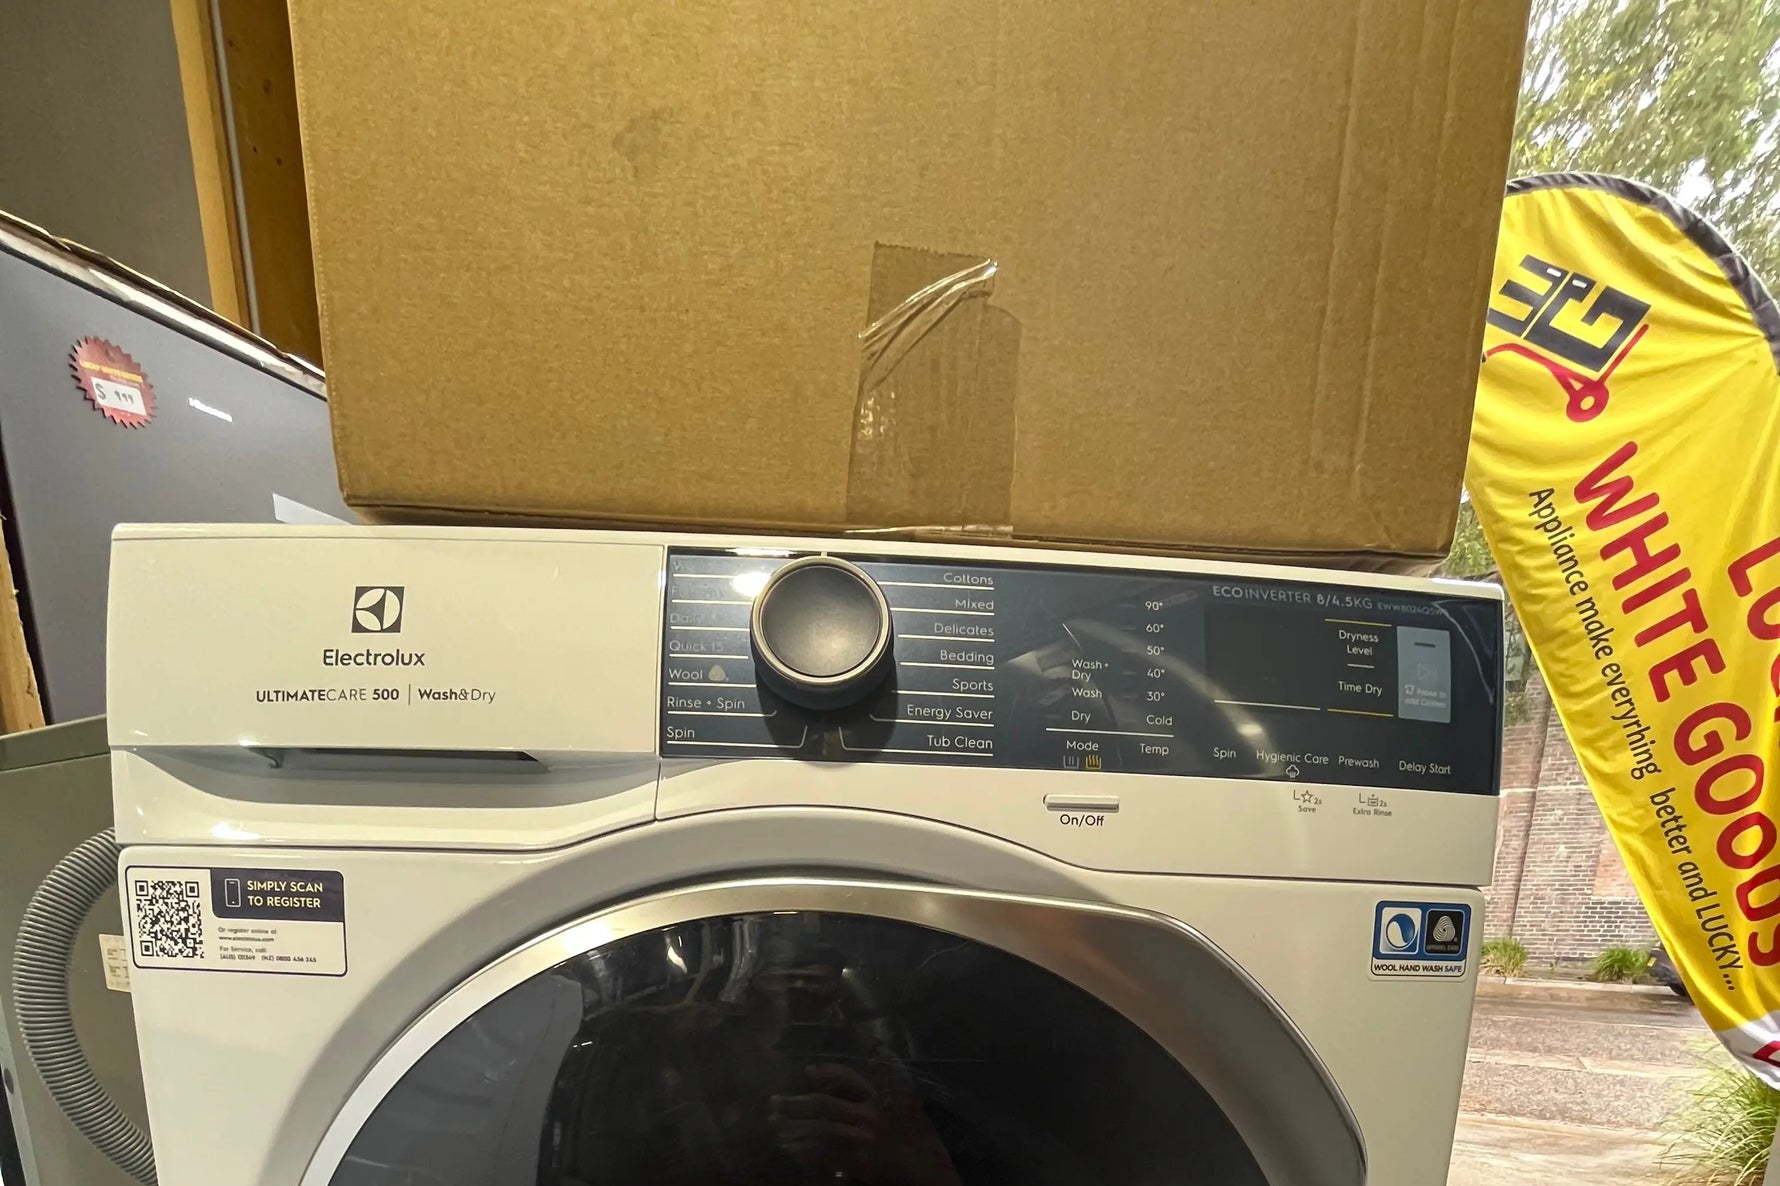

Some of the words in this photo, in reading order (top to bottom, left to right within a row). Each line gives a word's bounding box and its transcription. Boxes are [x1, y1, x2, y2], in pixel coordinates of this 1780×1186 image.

[1574, 440, 1726, 702] WHITE
[943, 572, 994, 586] Cottons
[1212, 585, 1312, 604] ECOINVERTER
[1316, 593, 1373, 610] 8/4.5KG
[955, 598, 994, 611] Mixed
[1145, 600, 1164, 611] 90°
[934, 622, 994, 637] Delicates
[1146, 623, 1165, 633] 60°
[1338, 629, 1380, 644] Dryness
[669, 639, 707, 653] Quick
[712, 640, 725, 654] 15
[1147, 645, 1165, 656] 50°
[1346, 644, 1373, 656] Level
[322, 649, 426, 666] Electrolux
[940, 649, 994, 666] Bedding
[668, 668, 703, 681] Wool
[1071, 670, 1092, 683] Dry
[1147, 667, 1165, 679] 40°
[952, 678, 994, 694] Sports
[1338, 681, 1362, 694] Time
[1364, 682, 1383, 697] Dry
[256, 688, 367, 703] ULTIMATECARE
[372, 688, 400, 701] 500
[418, 688, 496, 704] Wash&Dry
[1072, 687, 1103, 699] Wash
[1146, 691, 1165, 702] 30°
[1528, 487, 1589, 596] Appliance
[1575, 596, 1614, 660] make
[1650, 787, 1692, 855] better
[1677, 860, 1718, 902] and
[667, 696, 701, 709] Rinse
[716, 697, 745, 711] Spin
[907, 704, 951, 720] Energy
[955, 706, 993, 720] Saver
[1071, 710, 1091, 724] Dry
[1146, 714, 1173, 726] Cold
[666, 725, 695, 739] Spin
[927, 734, 950, 748] Tub
[954, 736, 993, 750] Clean
[1066, 740, 1099, 752] Mode
[1139, 743, 1170, 756] Temp
[1213, 747, 1237, 760] Spin
[1256, 750, 1300, 766] Hygienic
[1304, 753, 1329, 766] Care
[1338, 756, 1380, 769] Prewash
[1399, 761, 1423, 775] Delay
[1424, 762, 1452, 776] Start
[1298, 805, 1317, 813] Save
[1352, 807, 1371, 815] Extra
[1373, 808, 1392, 816] Rinse
[1059, 814, 1105, 828] On/Off
[247, 880, 287, 892] SIMPLY
[290, 881, 323, 893] SCAN
[247, 895, 264, 905] TO
[267, 896, 321, 908] REGISTER
[1374, 963, 1397, 972] WOOL
[1399, 964, 1420, 972] HAND
[1444, 965, 1462, 973] SAFE
